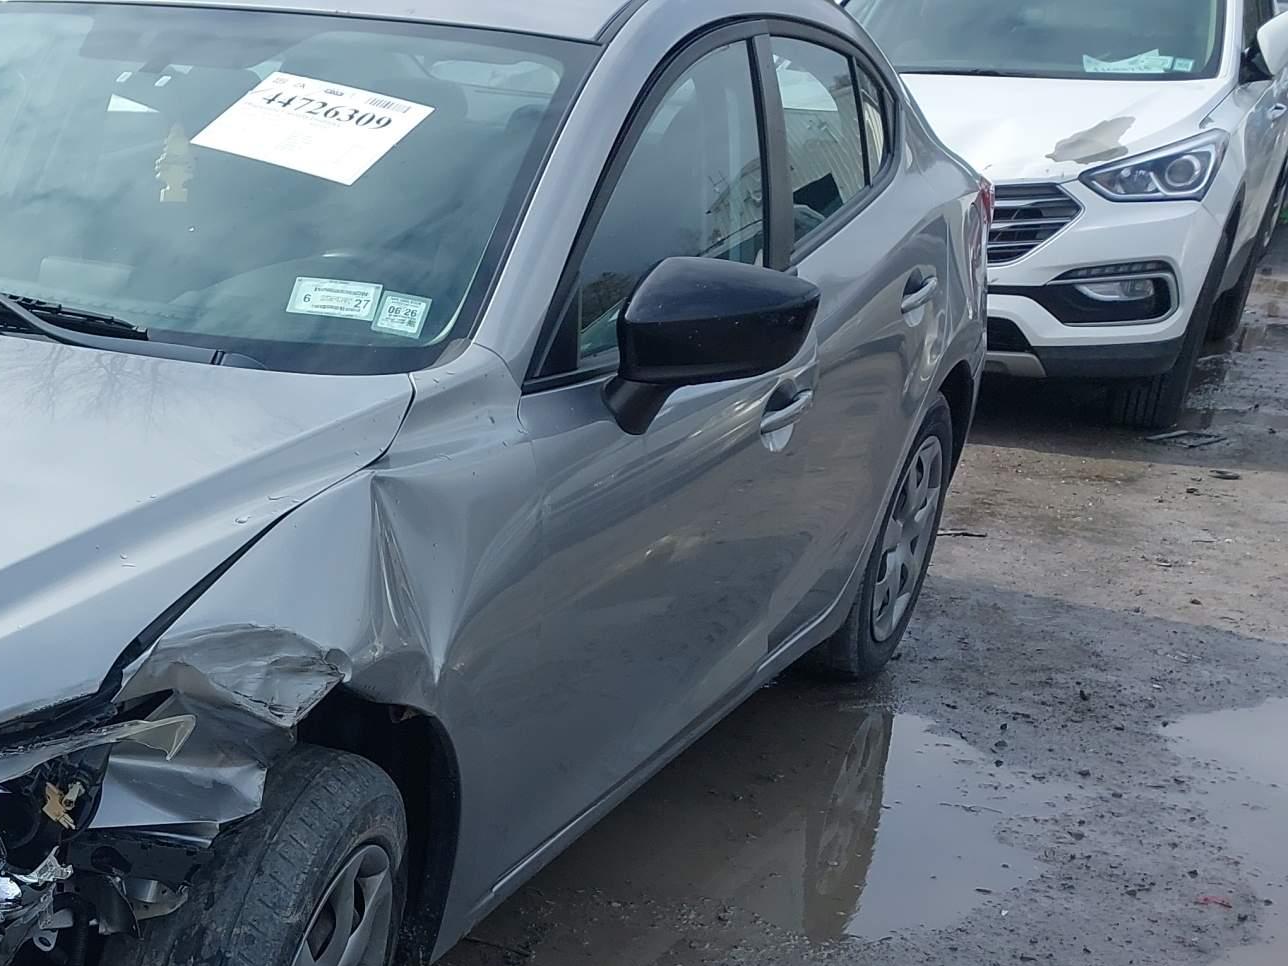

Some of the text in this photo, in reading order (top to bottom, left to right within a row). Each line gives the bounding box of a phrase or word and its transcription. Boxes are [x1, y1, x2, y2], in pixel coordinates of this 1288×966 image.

[262, 91, 392, 130] 44726309
[303, 294, 311, 303] 6
[354, 299, 371, 310] 27
